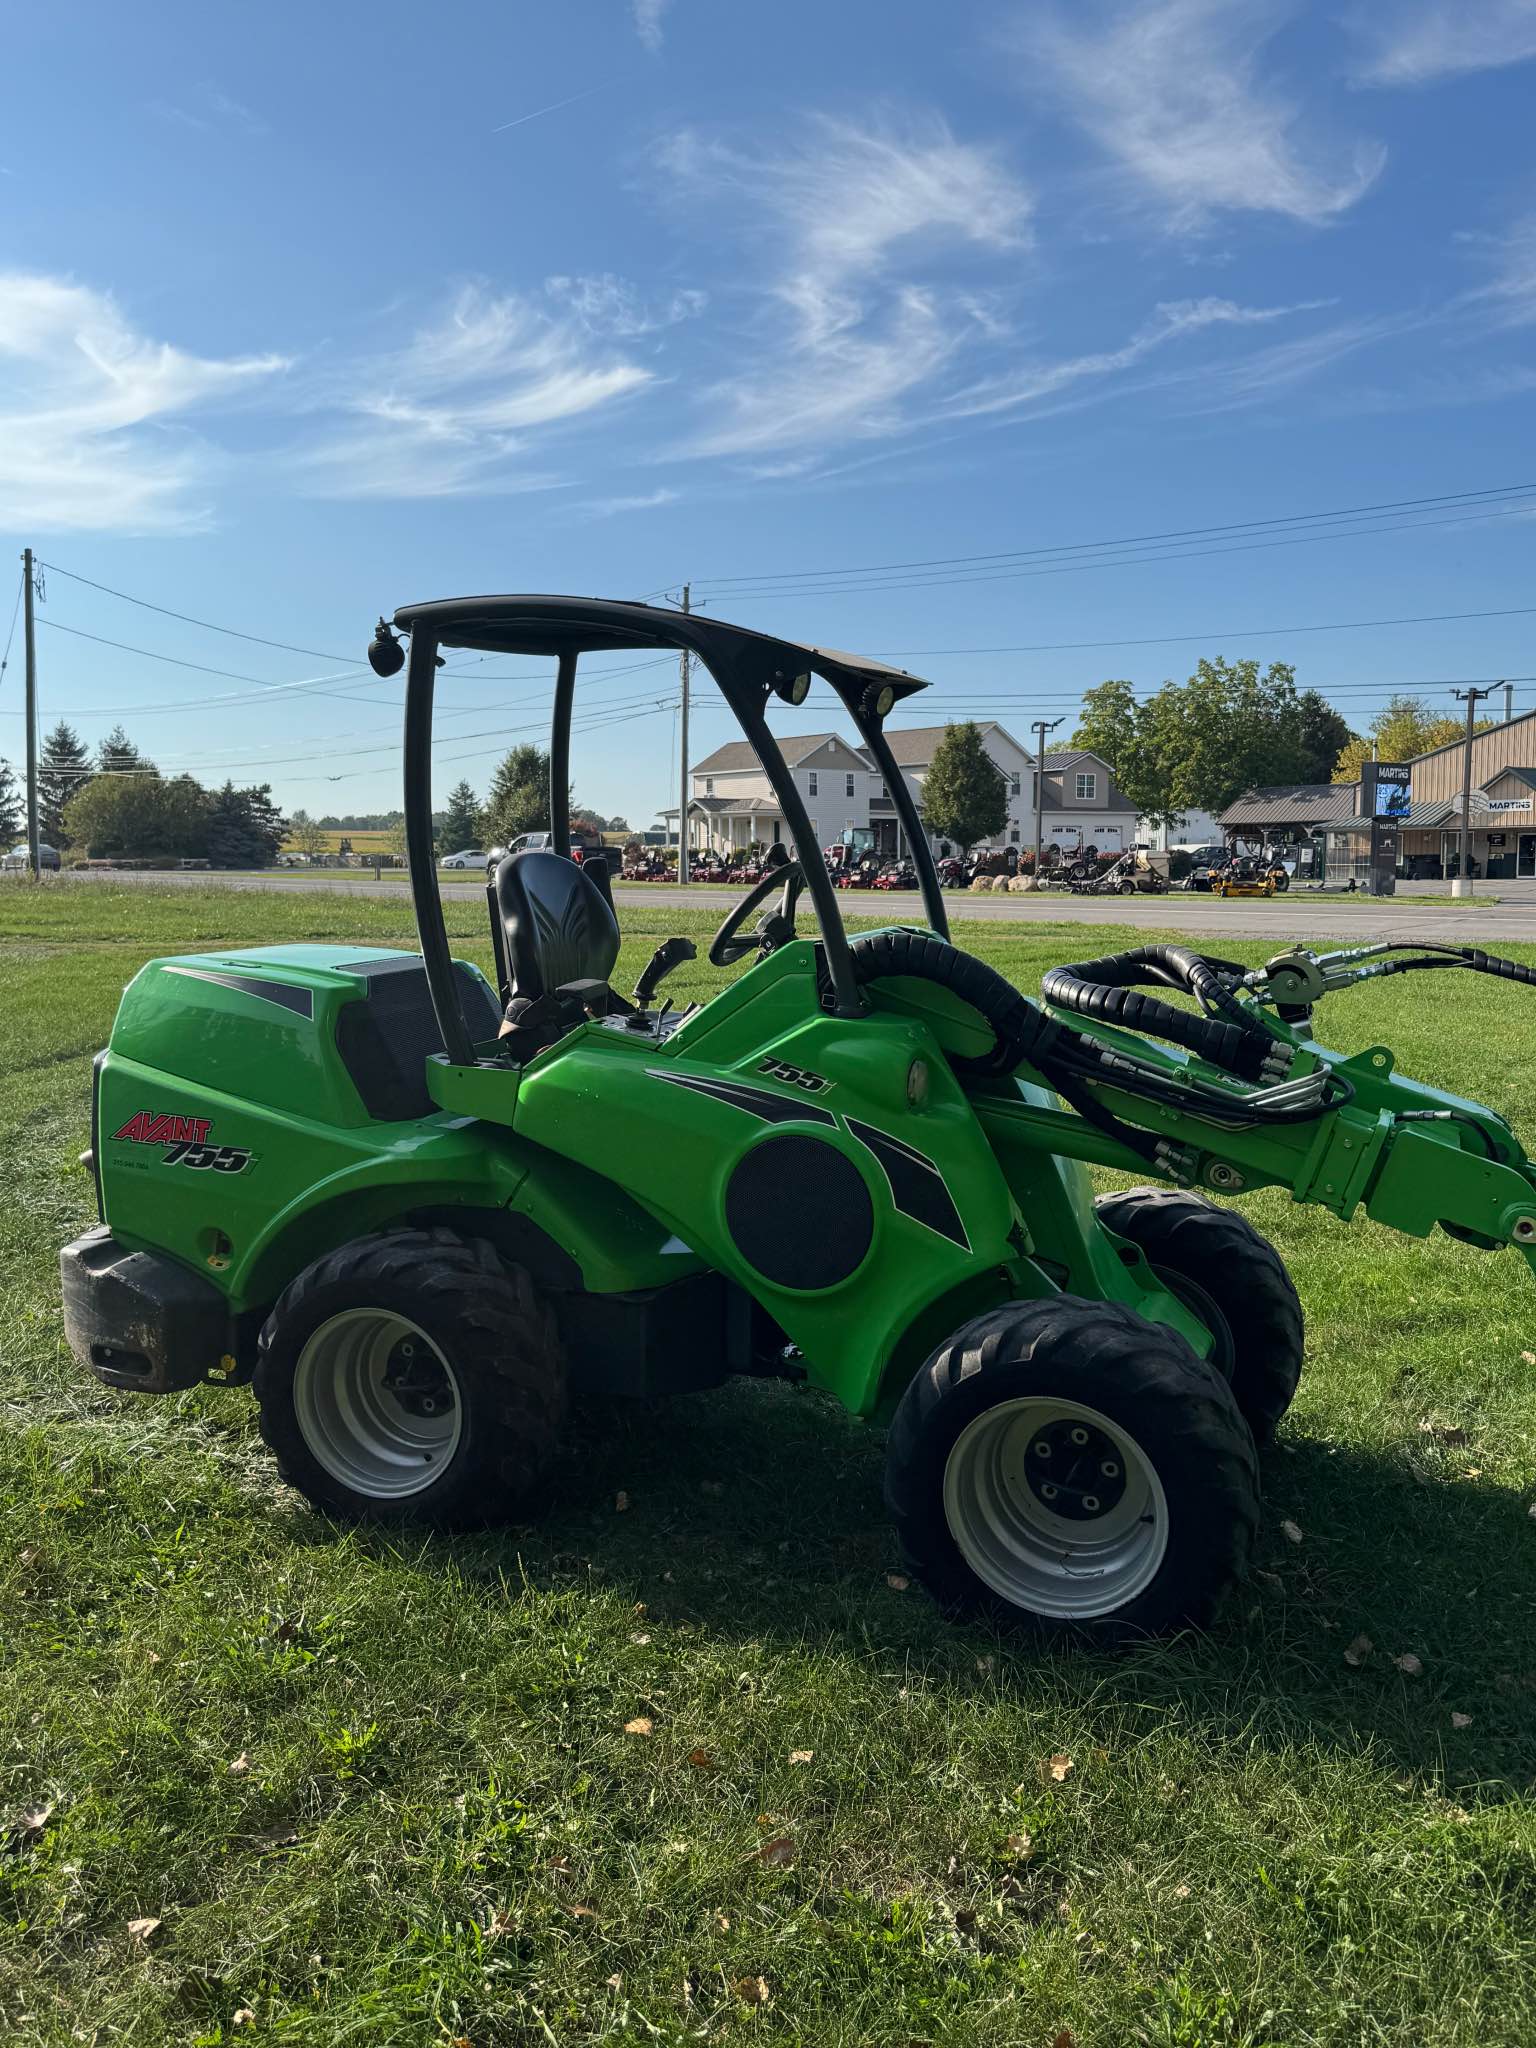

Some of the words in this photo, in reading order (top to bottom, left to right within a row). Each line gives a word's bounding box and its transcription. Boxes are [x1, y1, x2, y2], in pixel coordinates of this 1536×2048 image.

[1379, 768, 1409, 779] MARTINS
[1489, 801, 1531, 810] MARTINS
[109, 1110, 212, 1145] AVANT
